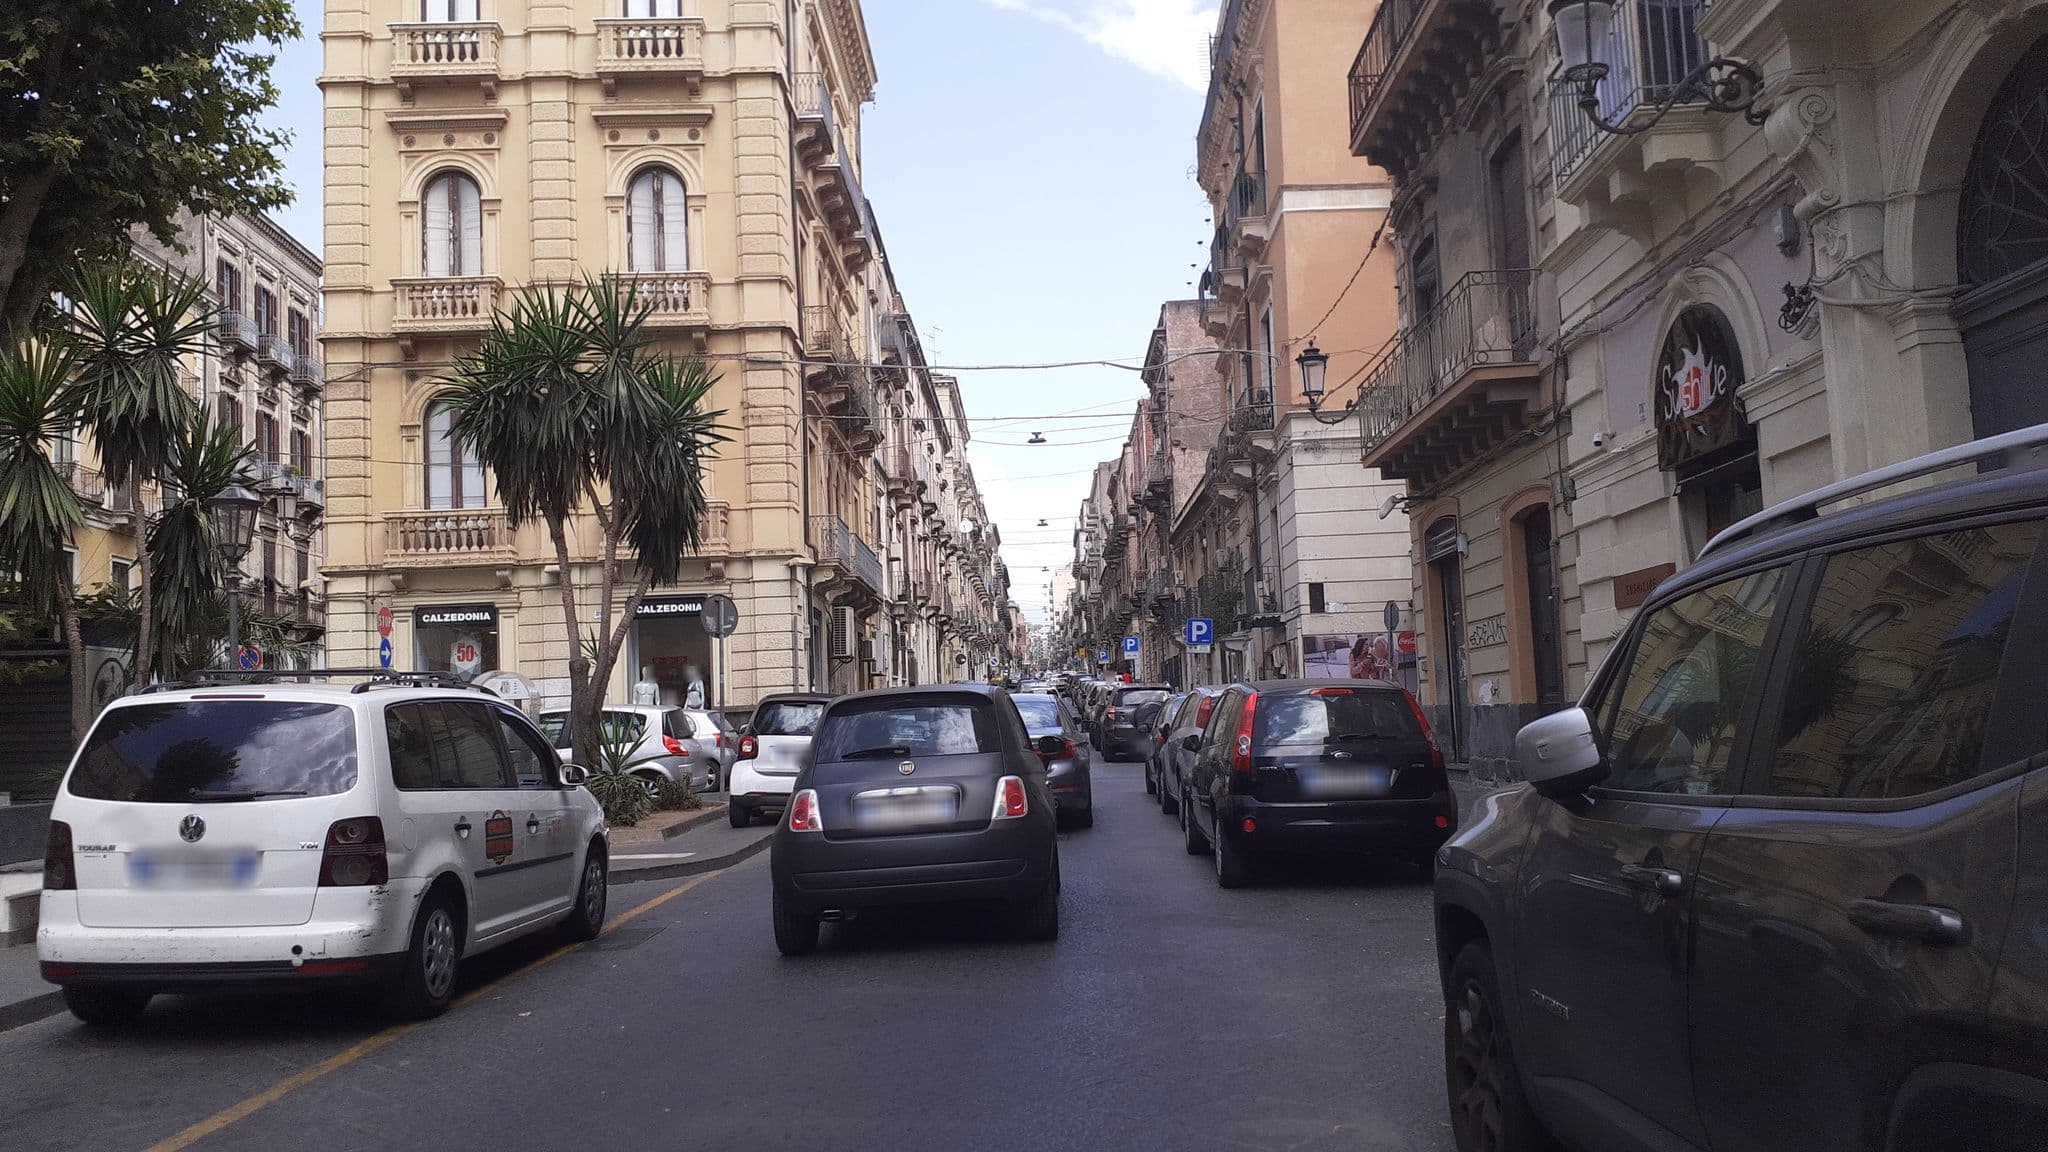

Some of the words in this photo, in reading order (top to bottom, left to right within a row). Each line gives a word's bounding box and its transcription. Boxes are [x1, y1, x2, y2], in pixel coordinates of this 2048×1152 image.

[637, 603, 703, 614] CALZEDONIA
[379, 615, 392, 628] STOP
[422, 612, 491, 623] CALZEDONIA
[1191, 621, 1208, 642] P
[1126, 638, 1136, 651] P
